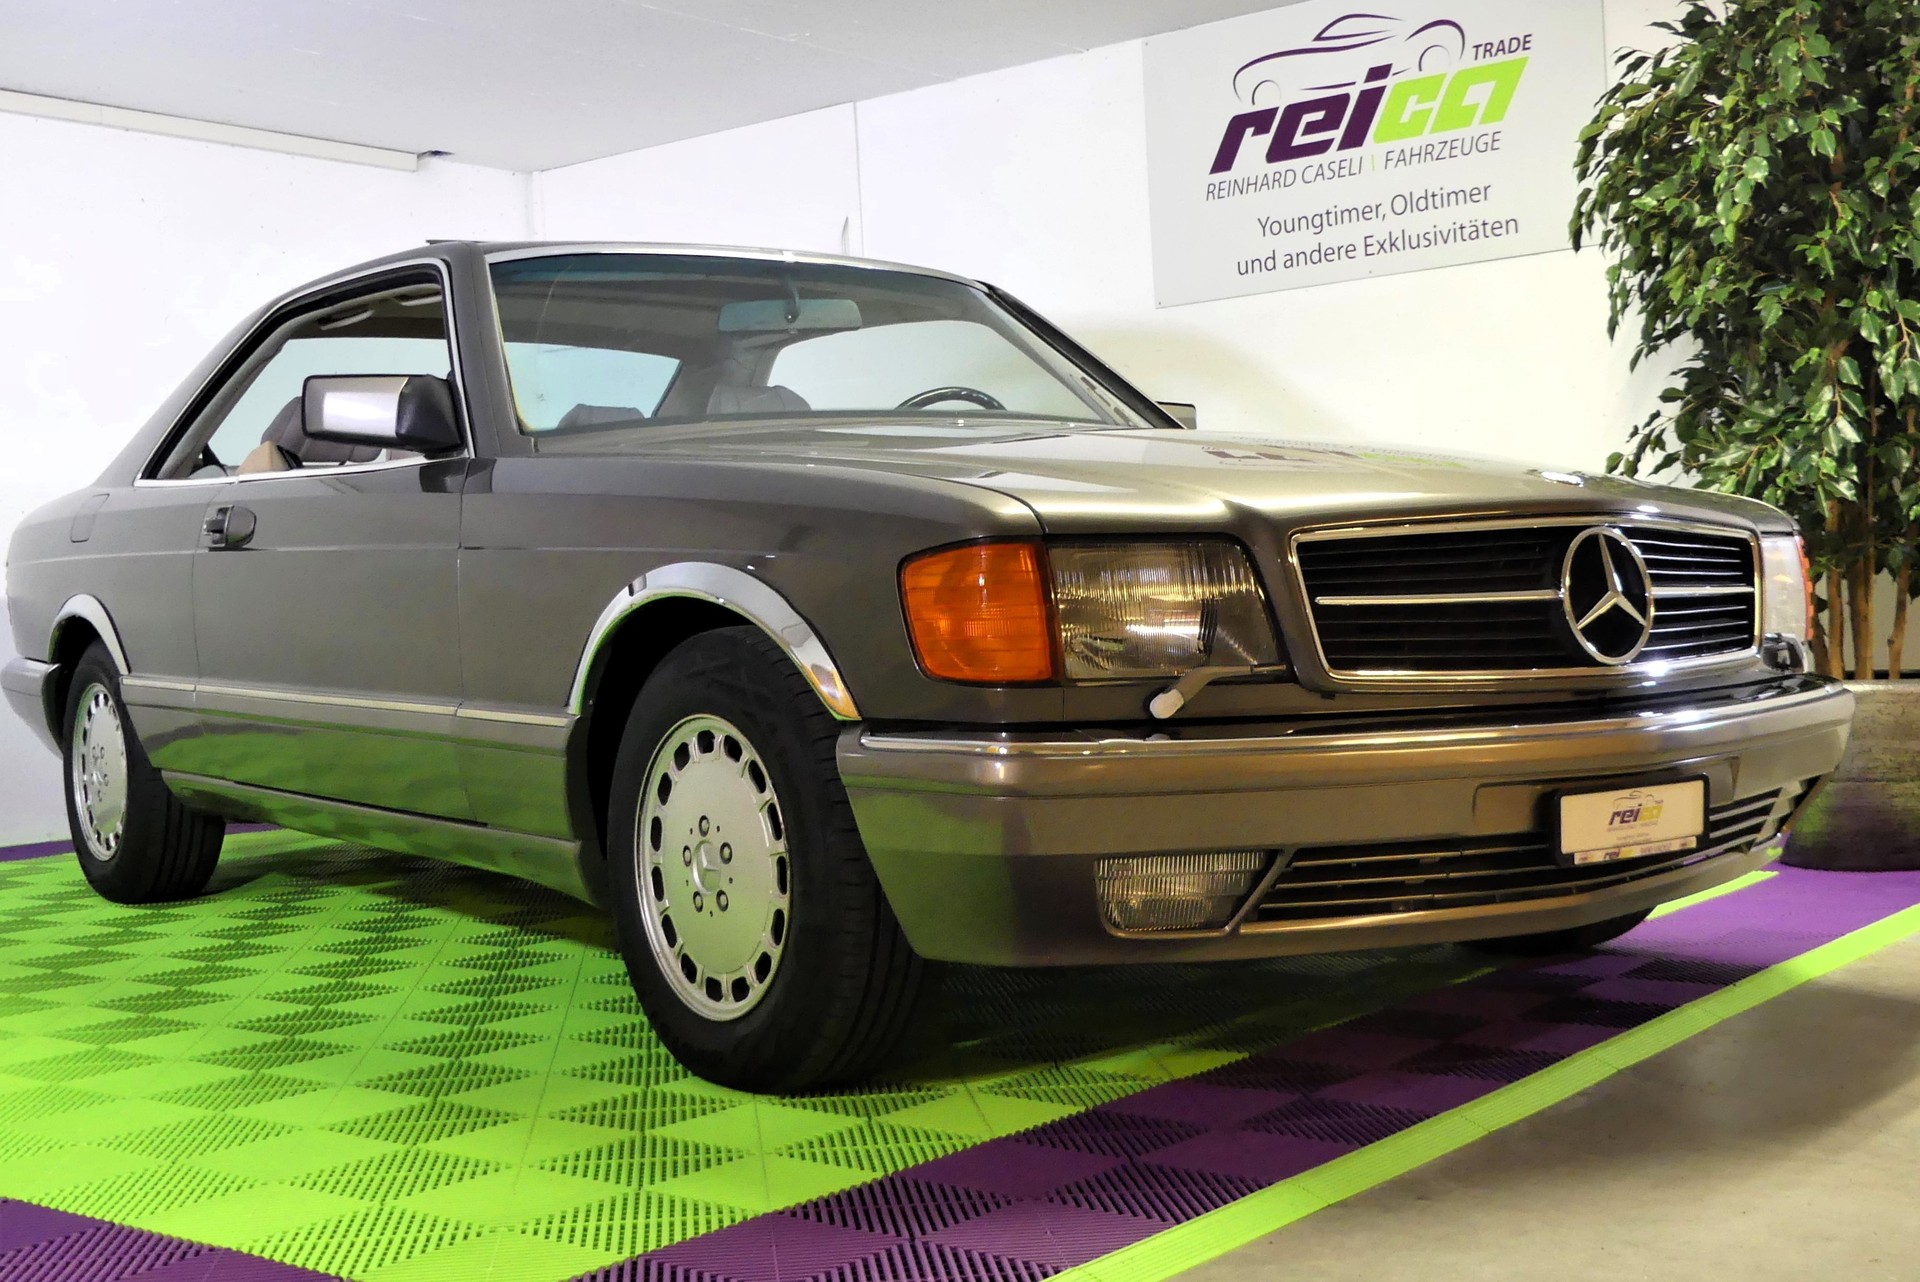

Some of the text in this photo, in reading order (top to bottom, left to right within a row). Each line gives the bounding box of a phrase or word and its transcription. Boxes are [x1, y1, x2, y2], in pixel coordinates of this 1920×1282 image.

[1472, 34, 1533, 61] TRADE
[1209, 55, 1530, 176] reica
[1206, 130, 1502, 202] REINHARD CASELI FAHRZEUGE
[1258, 184, 1492, 238] Youngtimer, Oldtimer
[1237, 218, 1519, 276] und andere Exklusivitäten
